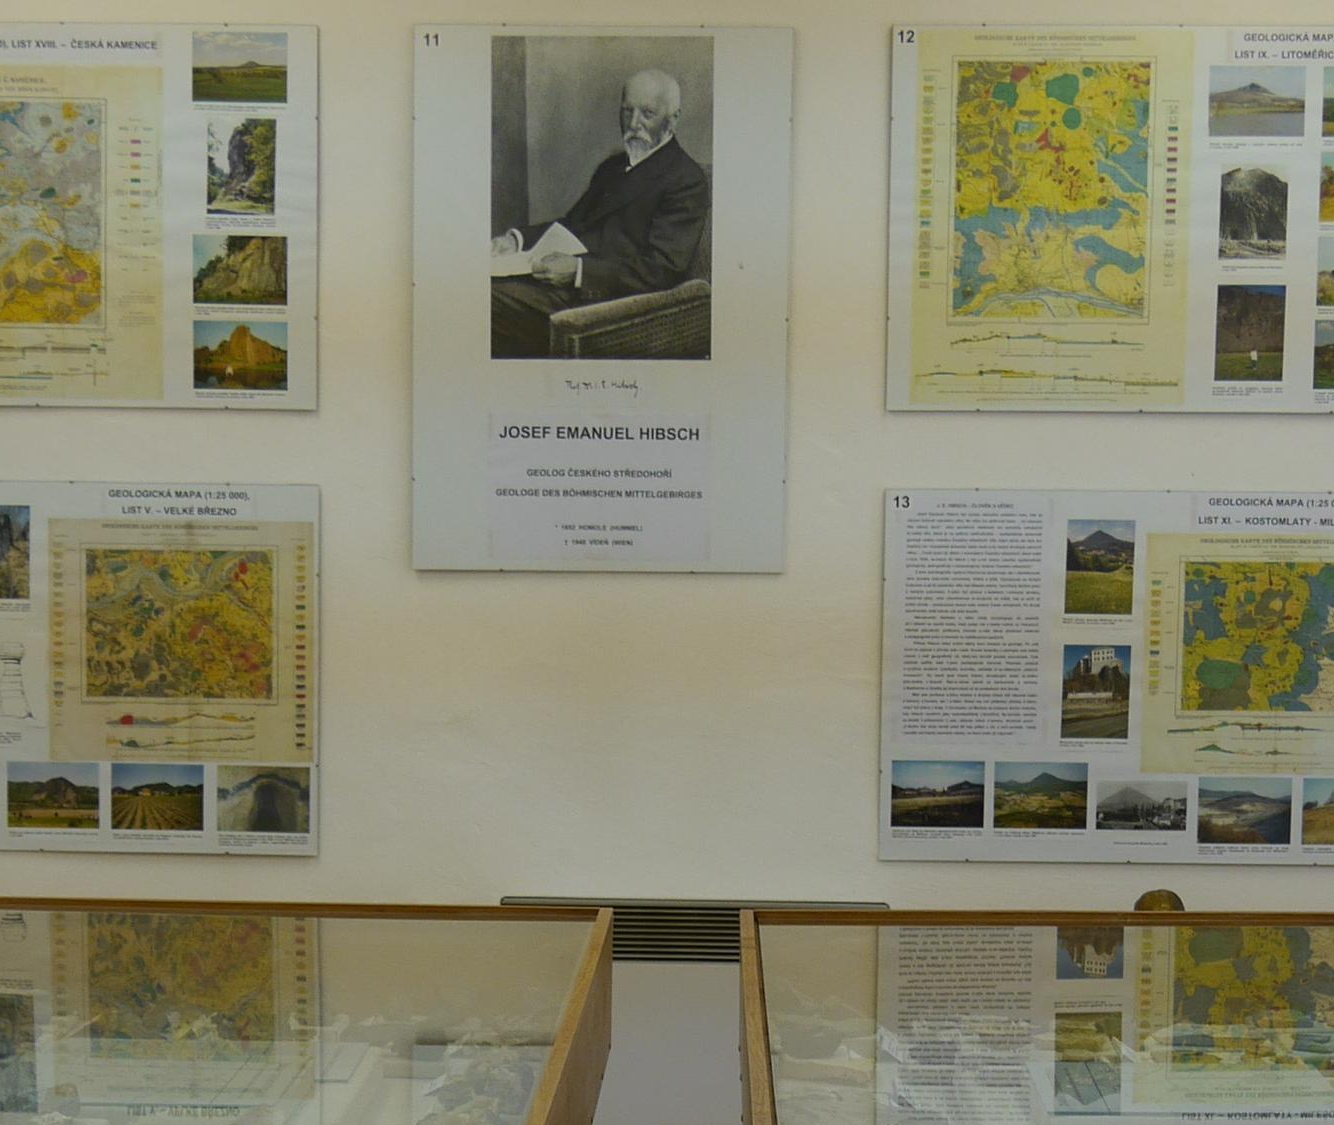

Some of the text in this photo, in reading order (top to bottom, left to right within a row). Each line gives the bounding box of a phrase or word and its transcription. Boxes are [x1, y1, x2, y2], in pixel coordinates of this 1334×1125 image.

[423, 34, 439, 47] 11
[896, 30, 915, 44] 12
[1243, 30, 1309, 44] GEOLOGICKÁ
[11, 40, 32, 49] LIST
[71, 38, 104, 50] ČESKÁ
[107, 41, 157, 50] KAMENICE
[1234, 50, 1256, 60] LIST
[499, 425, 700, 441] JOSEF EMANUEL HIBSCH
[526, 467, 672, 478] GEOLOG ČESKÉHO STŘEDOHOŘÍ
[108, 487, 172, 501] GEOLOGICKÁ
[174, 490, 202, 500] MAPA
[495, 488, 703, 499] GEOLOGE DES BÖHMISCHEN MITTELGEBIRGES
[893, 495, 910, 509] 13
[1209, 496, 1273, 507] GEOLOGICKÁ
[1276, 498, 1304, 507] MAPA
[121, 505, 143, 516] LIST
[163, 502, 194, 517] VELKÉ
[197, 504, 238, 517] BŘEZNO
[1198, 516, 1217, 525] LIST
[1245, 517, 1311, 527] KOSTOMLATY
